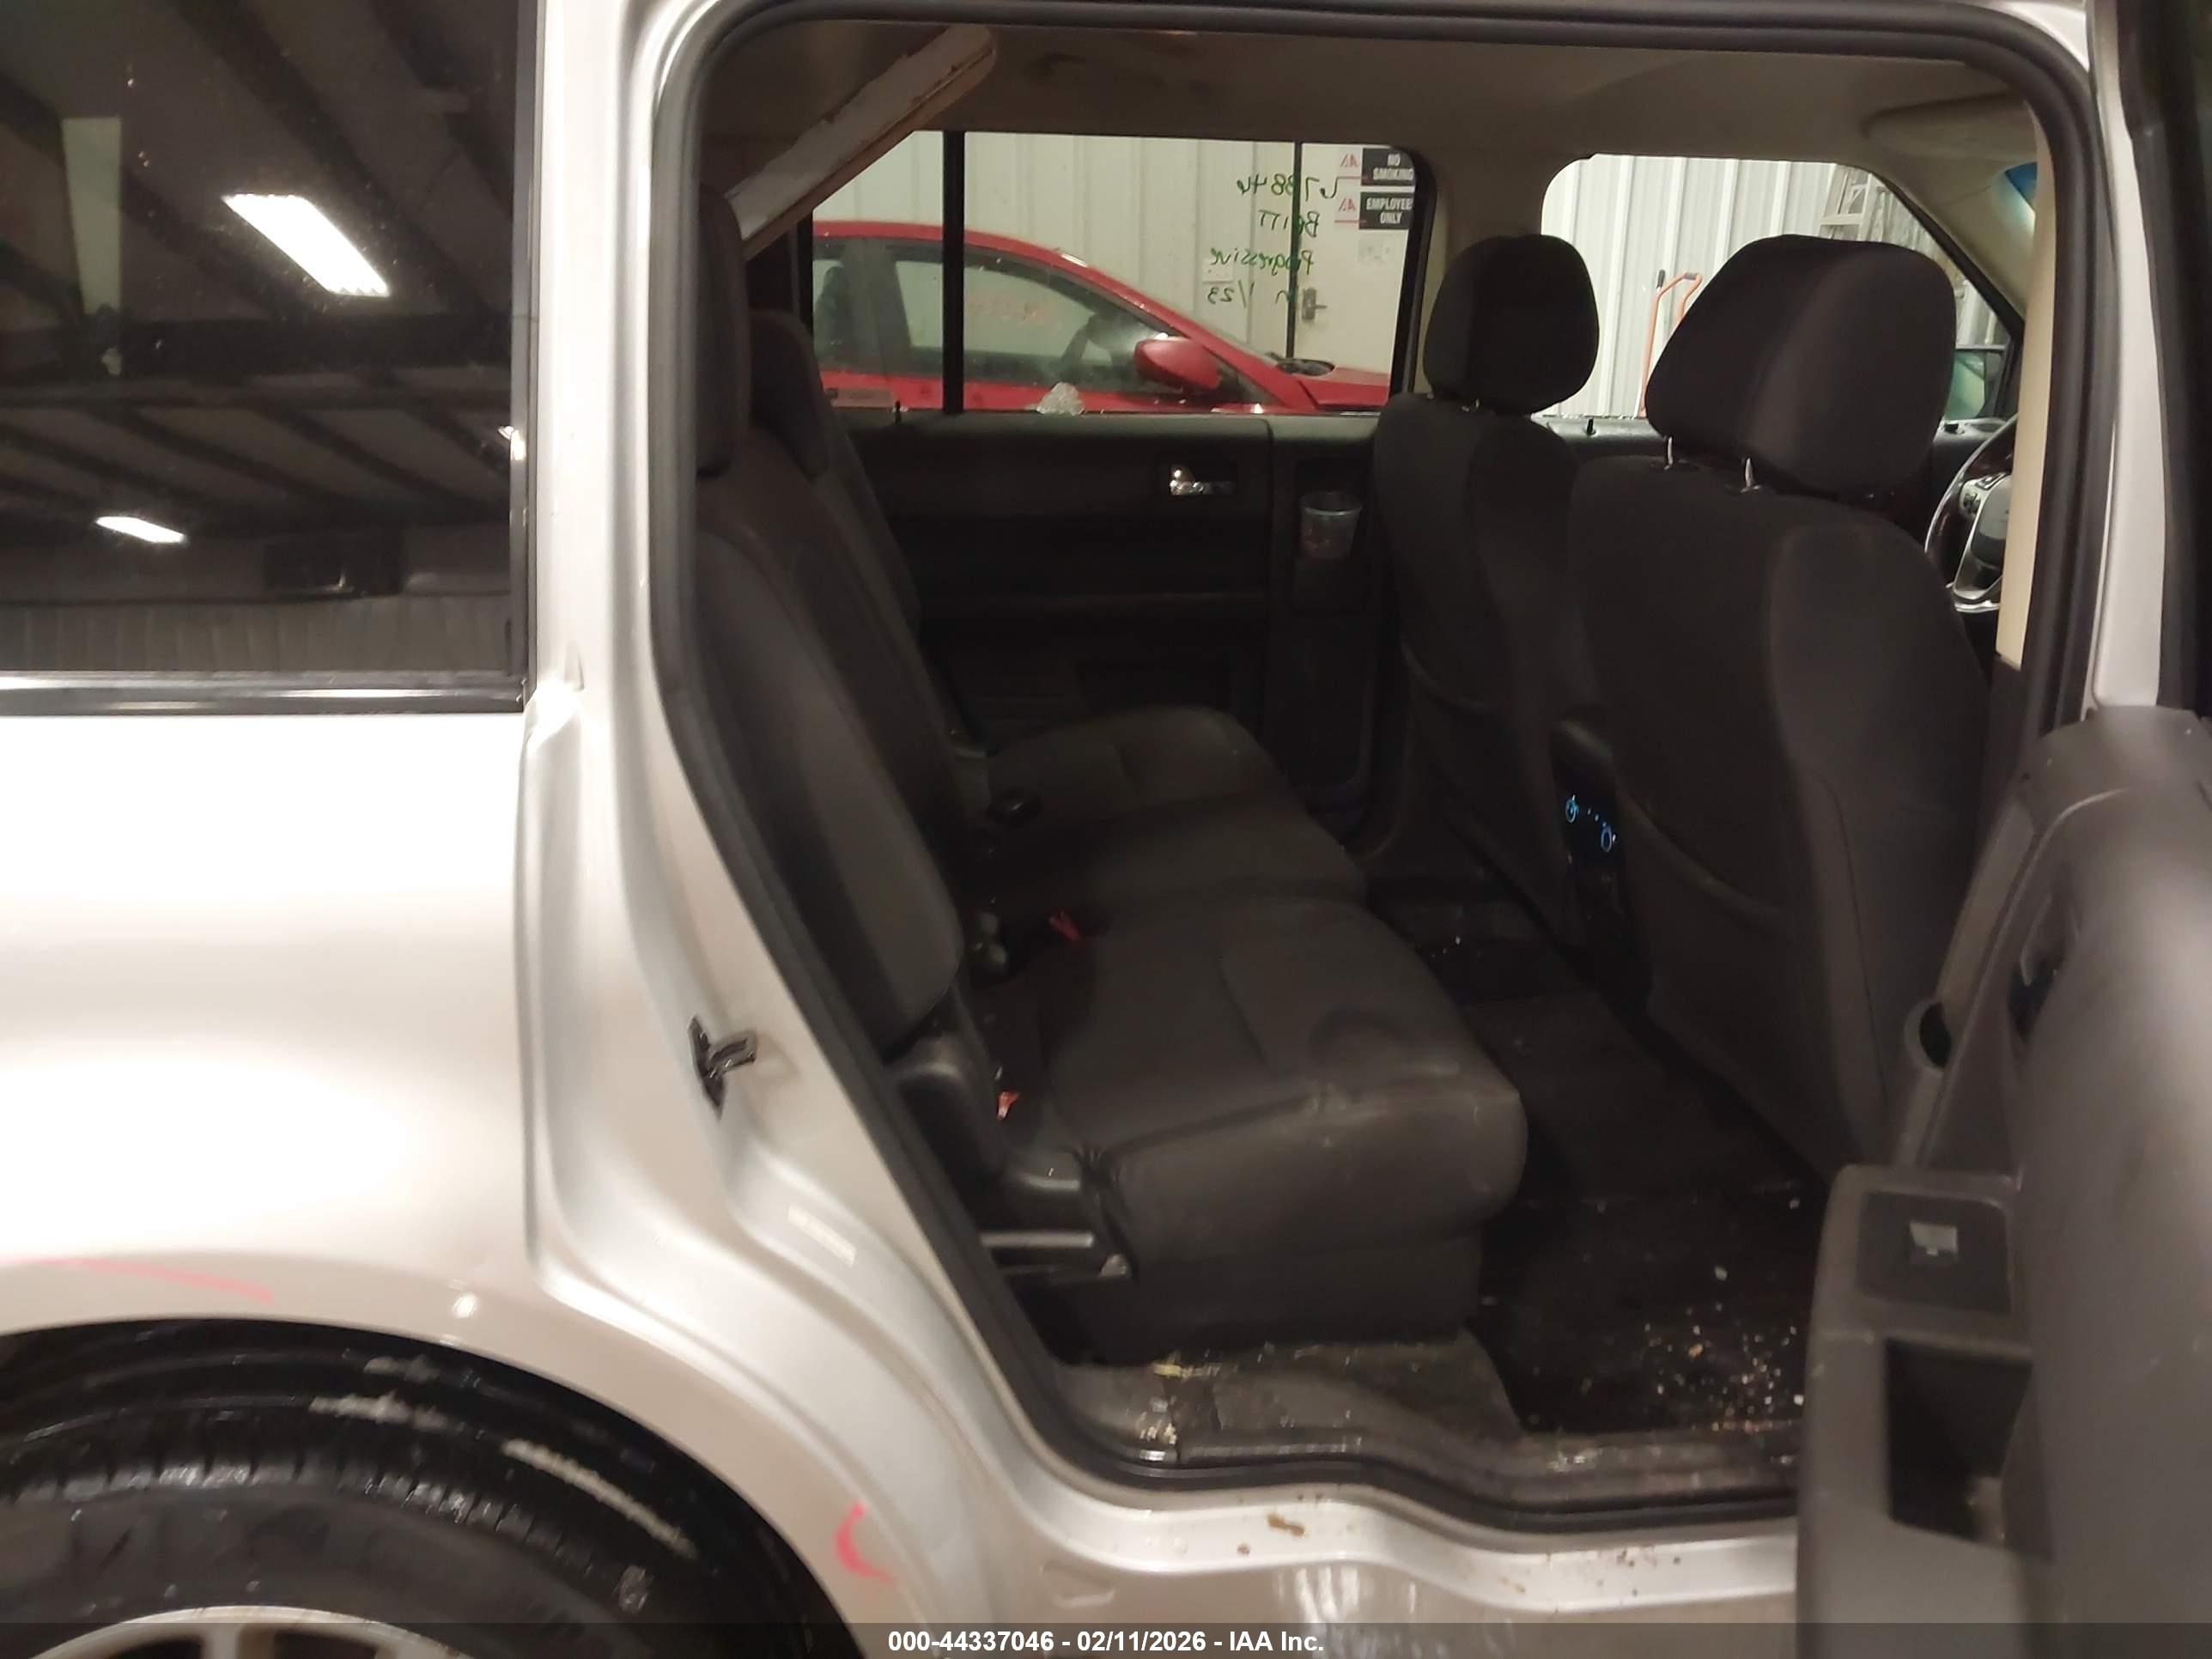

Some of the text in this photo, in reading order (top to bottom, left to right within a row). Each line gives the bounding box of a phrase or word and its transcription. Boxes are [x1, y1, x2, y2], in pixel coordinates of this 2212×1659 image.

[1387, 152, 1401, 167] NO
[1372, 167, 1414, 181] SMOKING
[1379, 211, 1403, 225] ONLY
